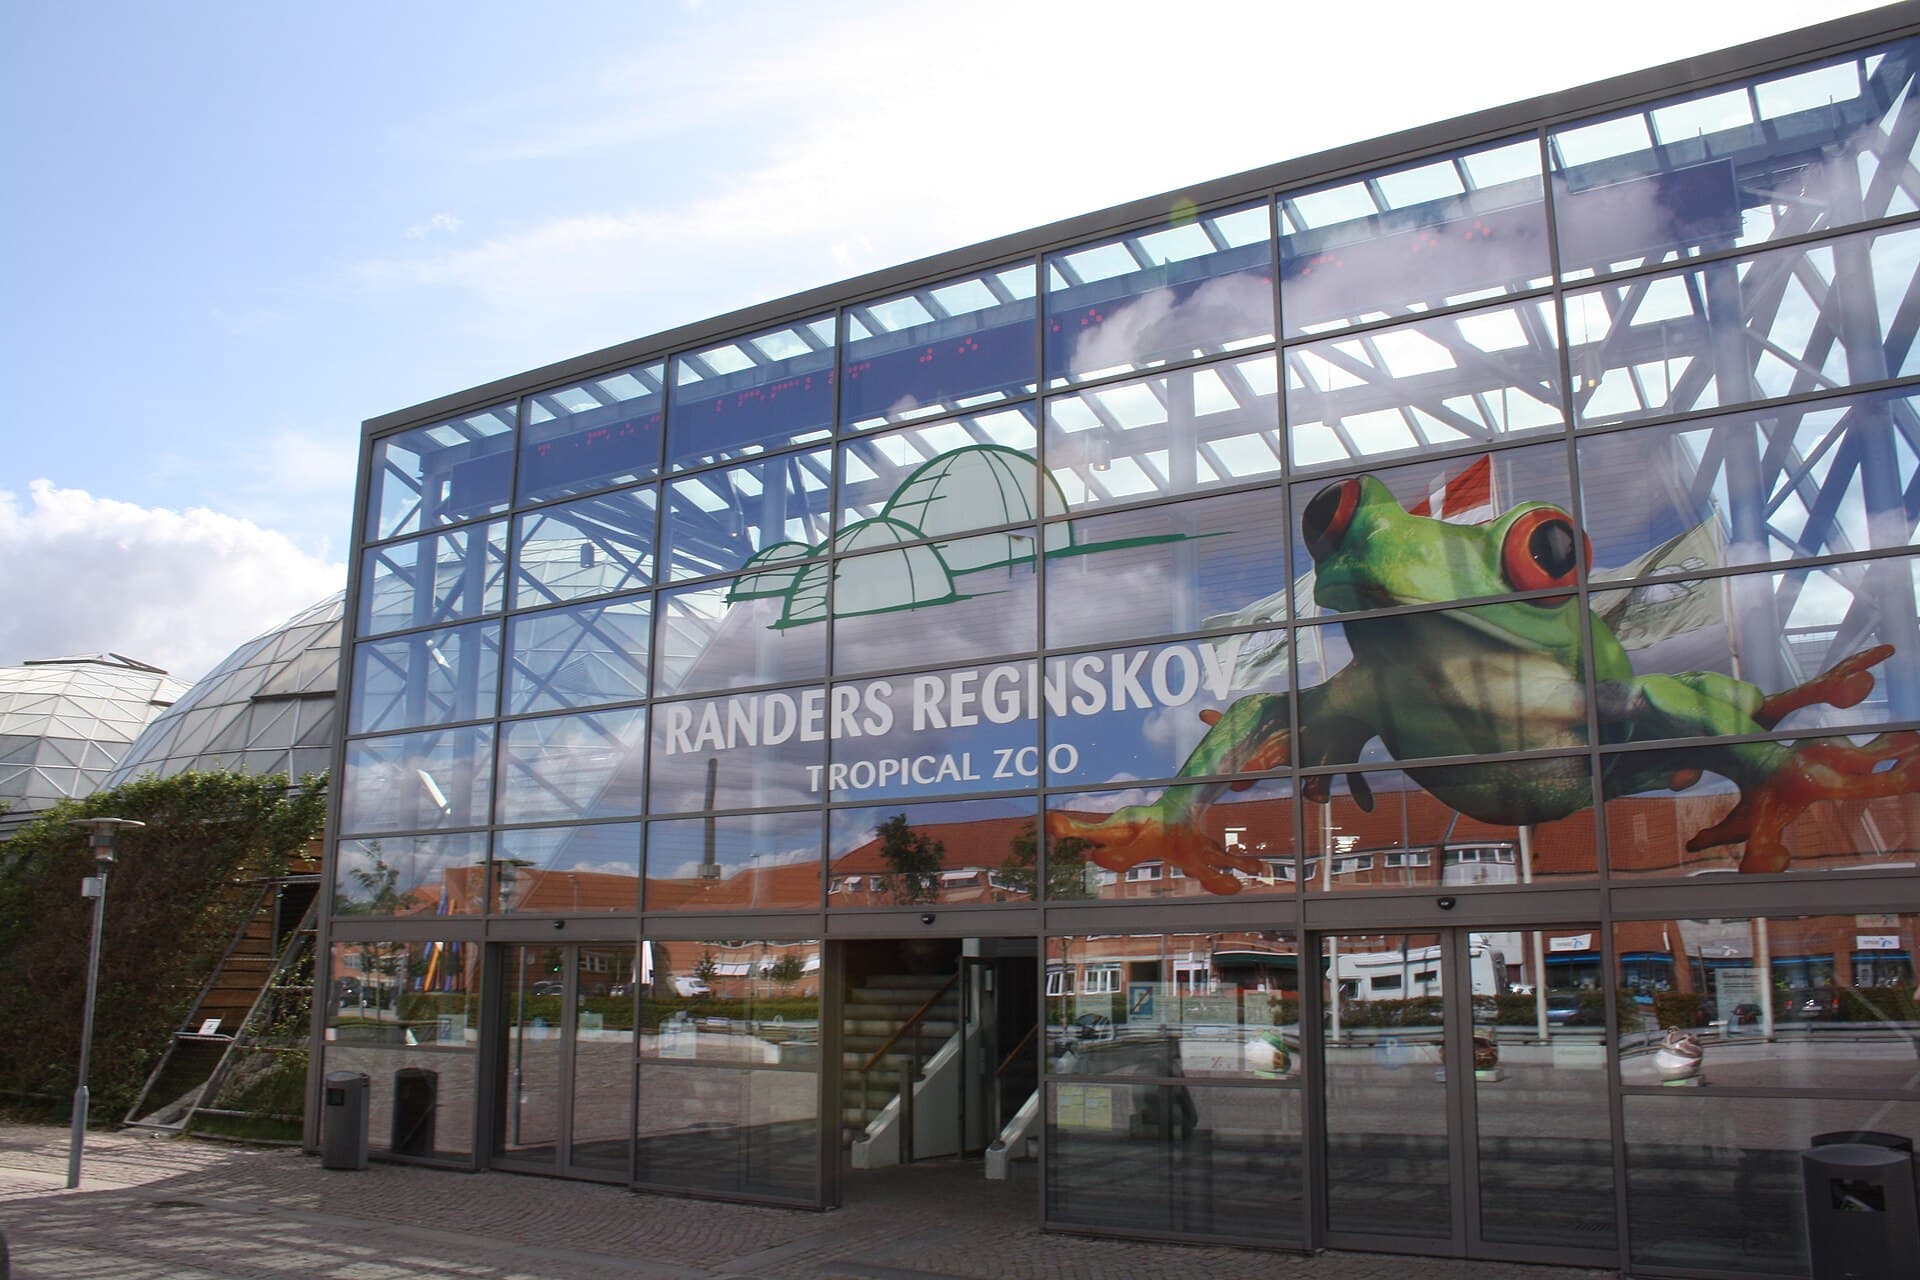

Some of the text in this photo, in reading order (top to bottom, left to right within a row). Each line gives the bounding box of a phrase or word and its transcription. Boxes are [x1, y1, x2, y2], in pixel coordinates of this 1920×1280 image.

[665, 642, 1242, 755] RANDERS REGNSKOV
[805, 743, 1079, 793] TROPICAL ZOO
